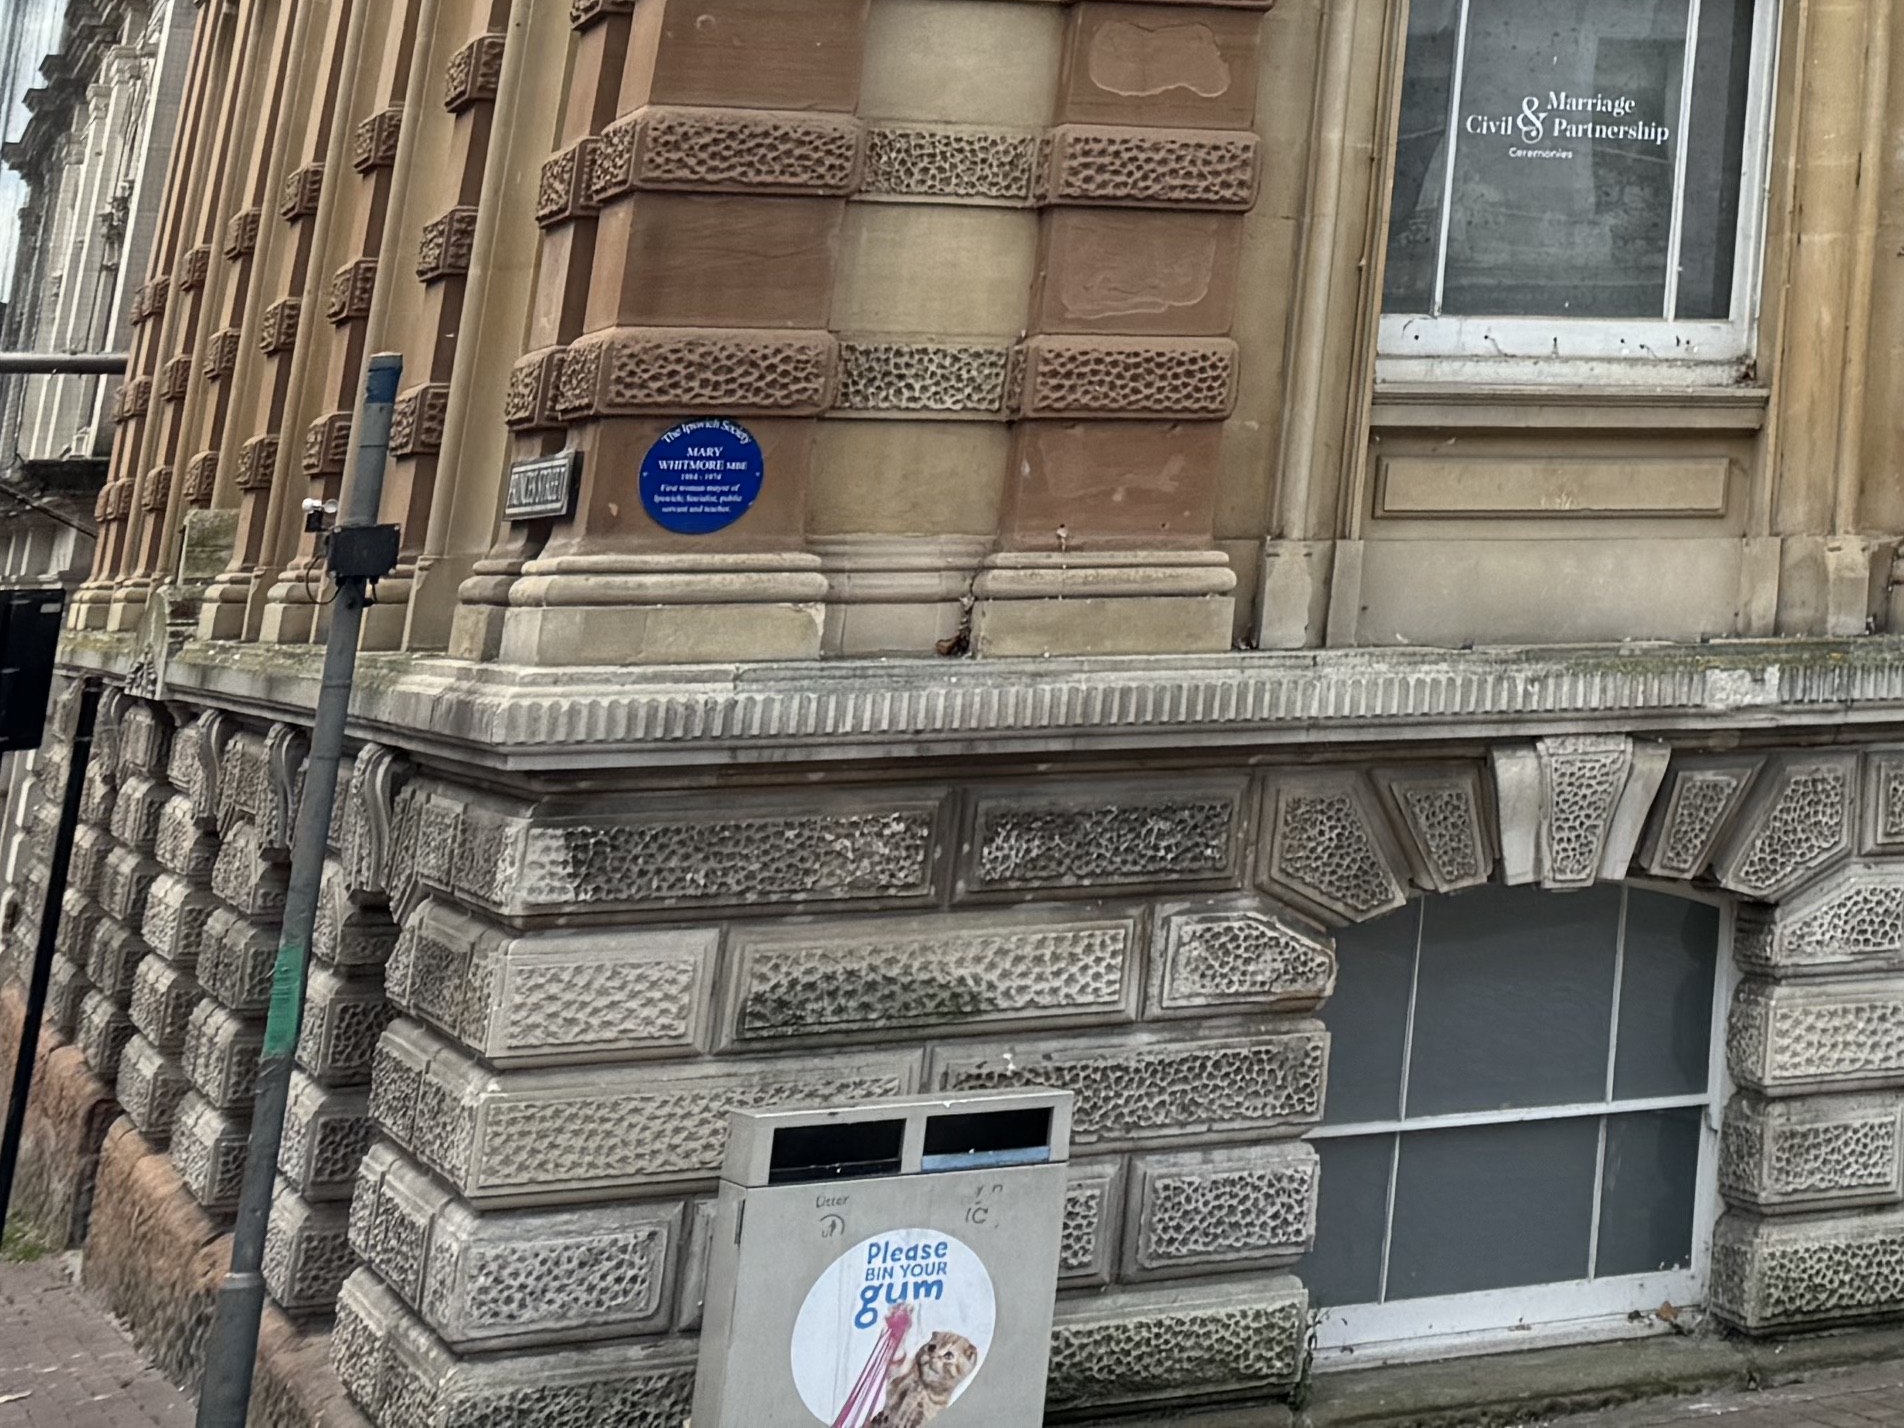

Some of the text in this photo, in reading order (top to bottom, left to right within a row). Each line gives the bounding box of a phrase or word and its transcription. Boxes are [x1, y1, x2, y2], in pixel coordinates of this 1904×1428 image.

[1546, 91, 1636, 117] Marriage
[1466, 96, 1669, 145] Civil & Partnership
[1508, 146, 1573, 159] Ceremonies
[661, 419, 752, 444] The Ipswich Society
[687, 446, 723, 457] MARY
[658, 459, 724, 470] WHITMORE
[867, 1240, 948, 1265] Please
[865, 1261, 948, 1282] BIN YOUR
[854, 1278, 944, 1330] gum
